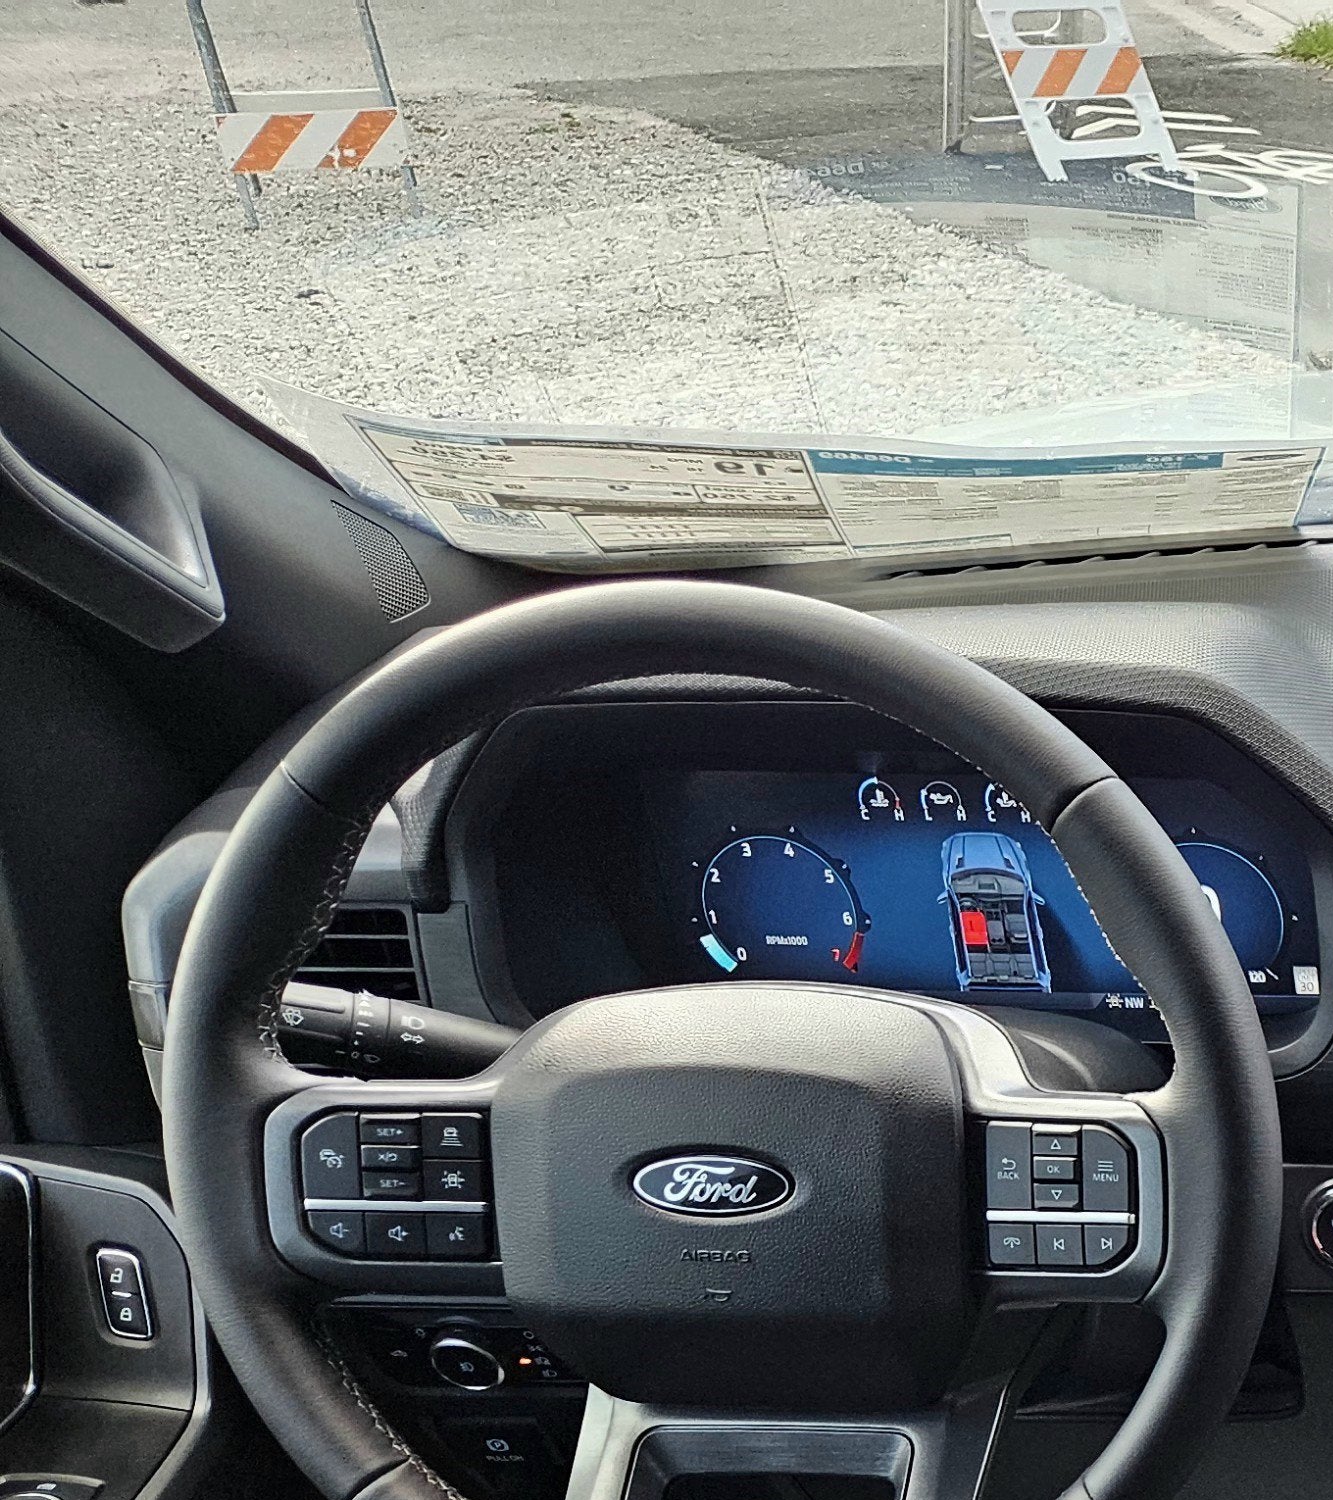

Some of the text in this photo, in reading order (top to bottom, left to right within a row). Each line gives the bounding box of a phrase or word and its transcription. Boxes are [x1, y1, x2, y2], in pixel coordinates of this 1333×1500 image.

[860, 808, 870, 821] C
[894, 808, 905, 822] H
[924, 809, 934, 822] L
[956, 808, 967, 822] H
[987, 810, 997, 823] C
[1020, 810, 1032, 824] H
[740, 842, 752, 858] 3
[783, 843, 795, 858] 4
[709, 868, 722, 884] 2
[824, 869, 835, 884] 5
[708, 908, 718, 925] 1
[842, 911, 853, 926] 6
[736, 946, 748, 962] 0
[1300, 981, 1315, 992] 30
[1124, 996, 1145, 1009] NW
[997, 1171, 1020, 1180] BACK
[1046, 1165, 1060, 1174] OK
[663, 1163, 759, 1204] Ford
[1092, 1173, 1119, 1182] MENU
[679, 1248, 751, 1263] AIRBAG
